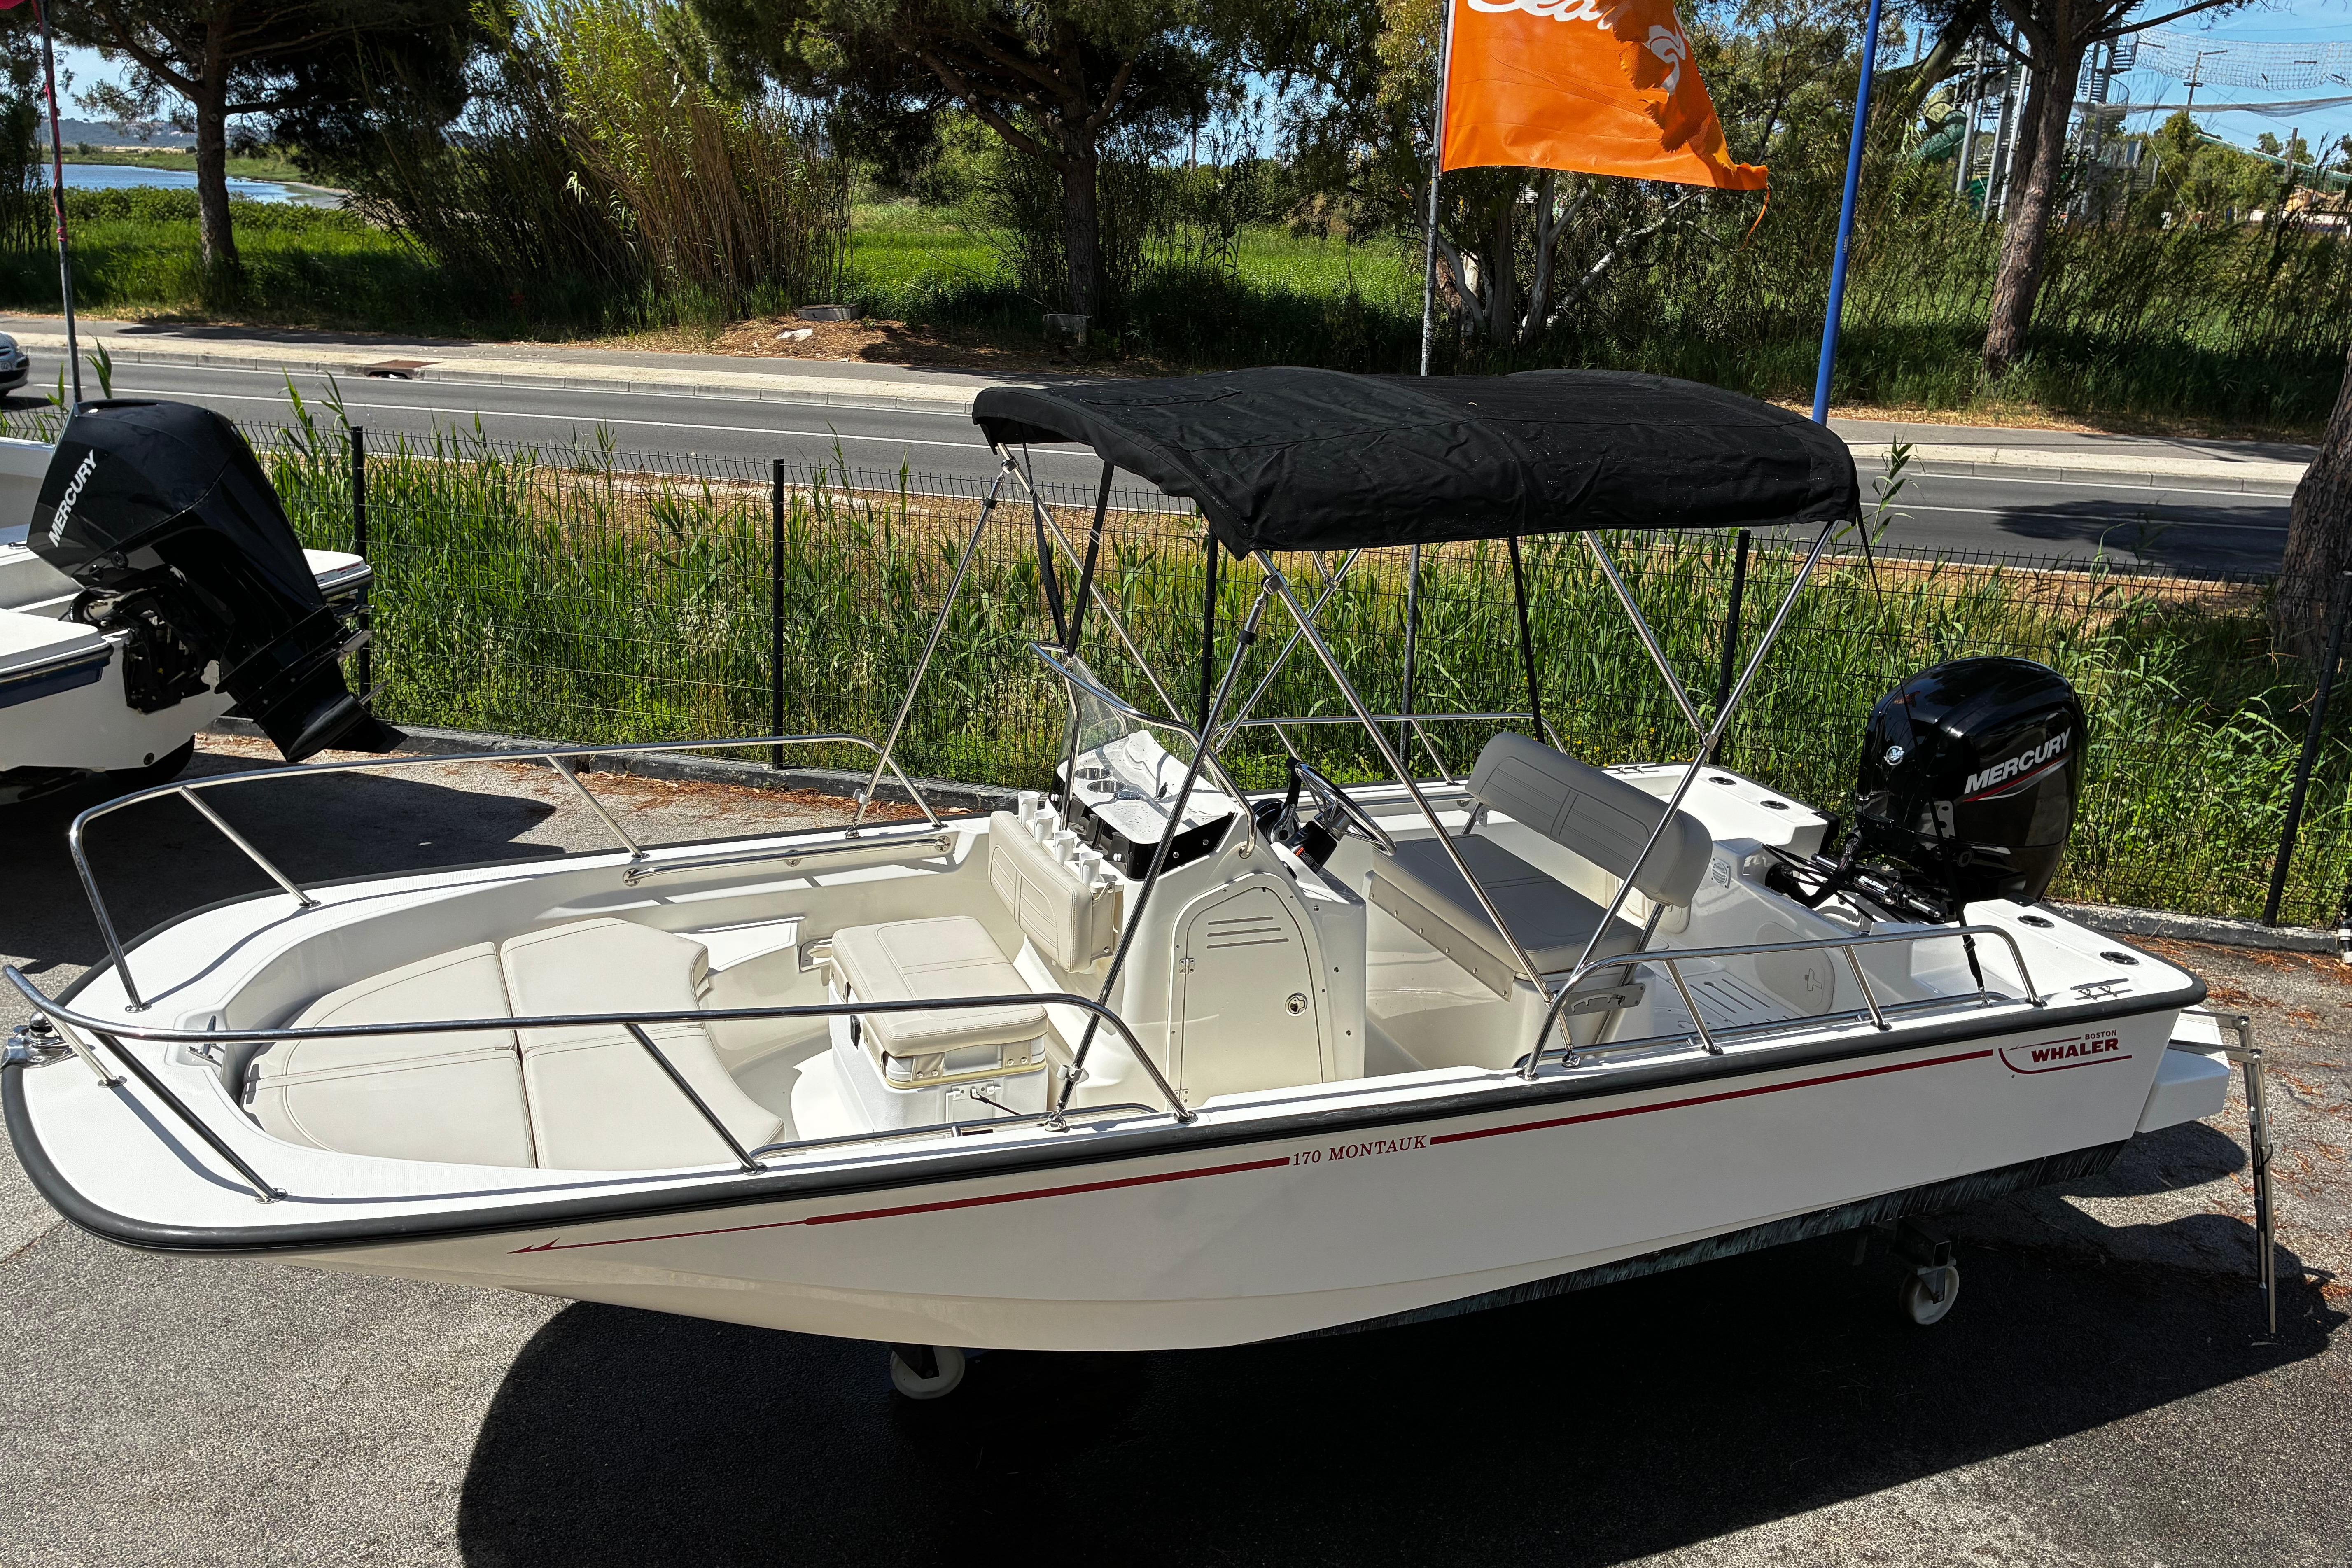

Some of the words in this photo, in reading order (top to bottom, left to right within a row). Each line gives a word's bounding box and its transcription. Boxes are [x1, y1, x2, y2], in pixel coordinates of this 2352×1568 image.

[49, 449, 96, 547] MERCURY
[1964, 726, 2071, 794] MERCURY
[2031, 1038, 2119, 1063] WHALER
[2085, 1030, 2116, 1040] BOSTON
[1293, 1150, 1321, 1166] 170
[1328, 1135, 1427, 1161] MONTAUK
